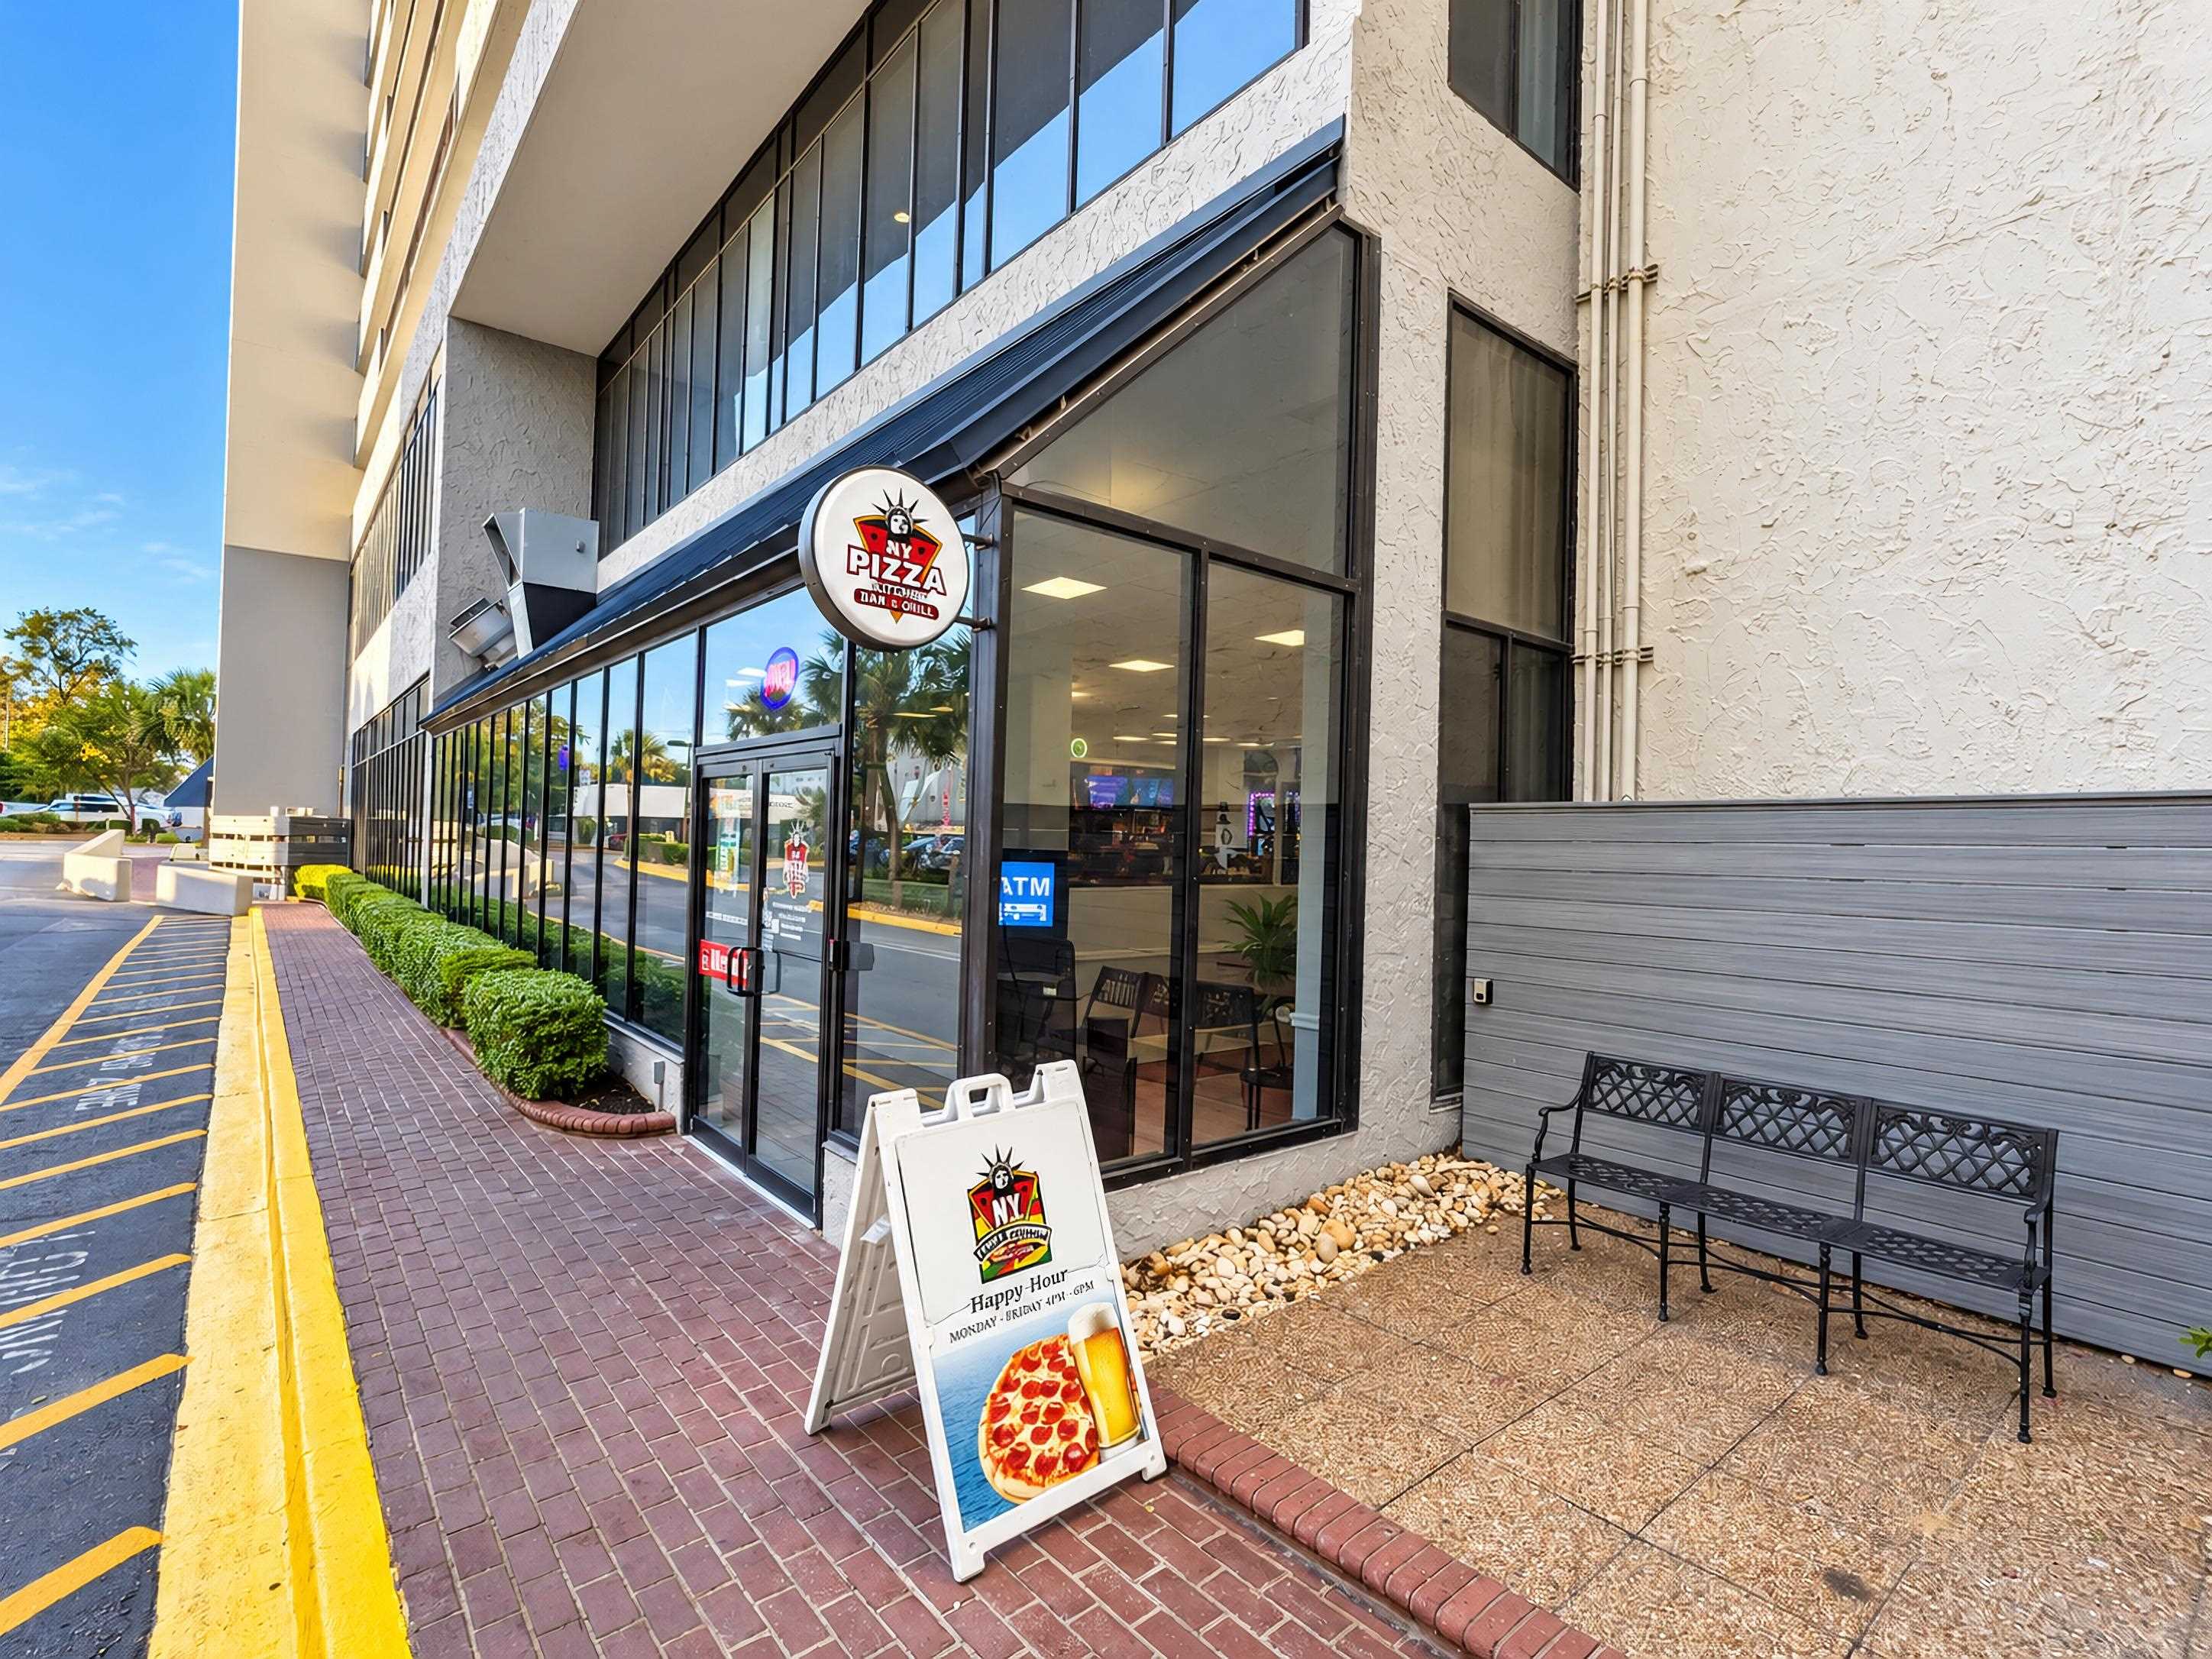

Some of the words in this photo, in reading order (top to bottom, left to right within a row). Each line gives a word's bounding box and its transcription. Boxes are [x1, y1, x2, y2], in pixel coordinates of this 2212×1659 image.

[885, 540, 913, 559] NY
[848, 545, 946, 595] PIZZA
[1001, 876, 1049, 897] ATM
[991, 1193, 1024, 1227] NY
[970, 1285, 1023, 1314] Happy
[1029, 1269, 1069, 1294] Hour
[949, 1316, 998, 1344] MONDAY
